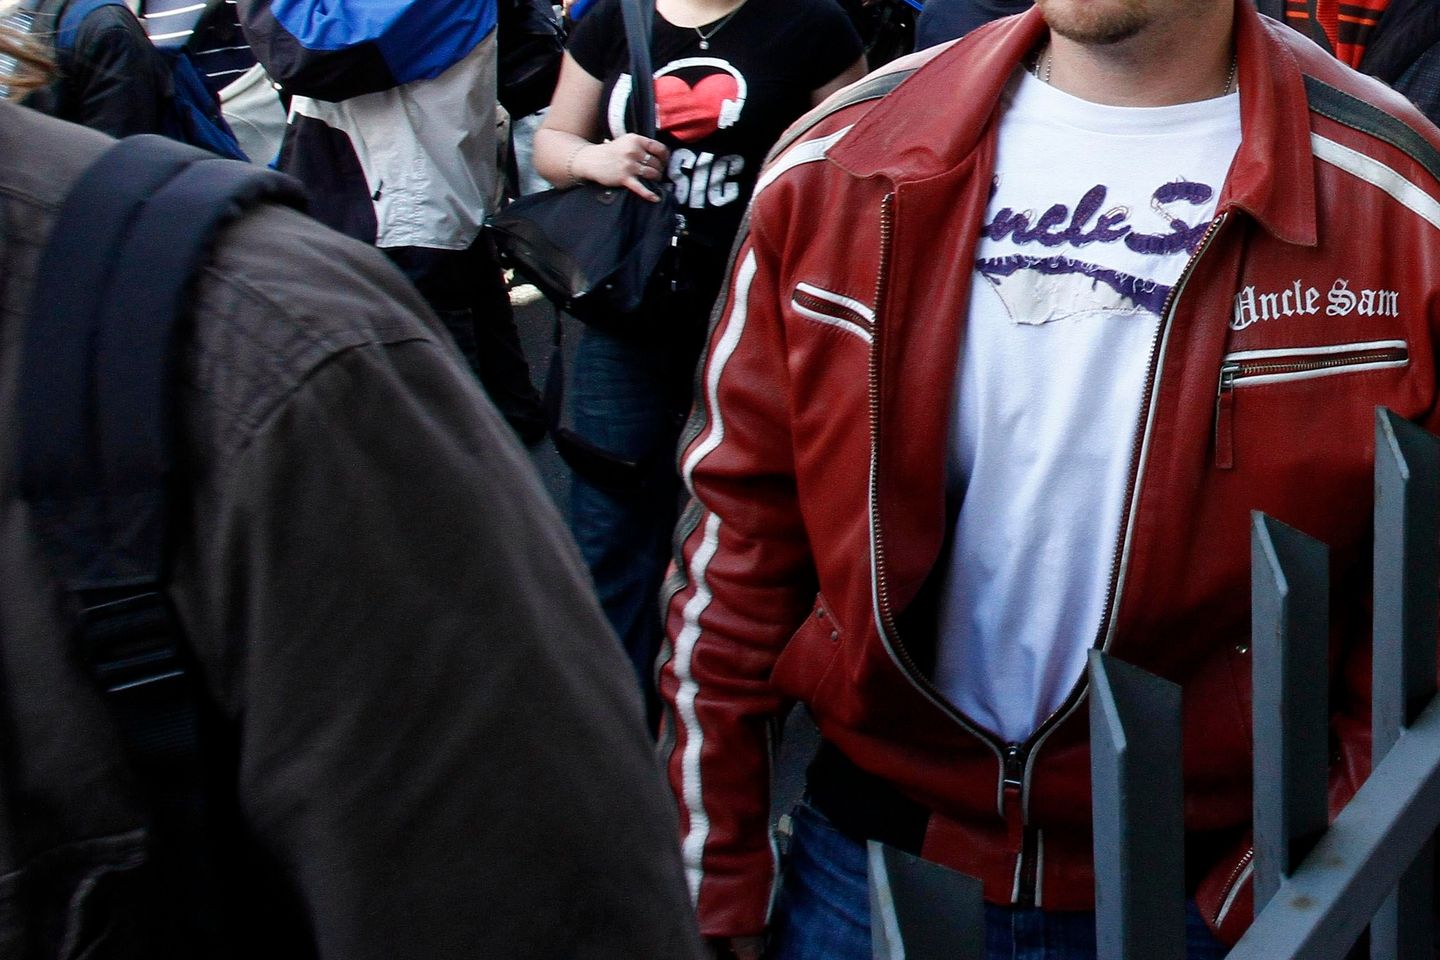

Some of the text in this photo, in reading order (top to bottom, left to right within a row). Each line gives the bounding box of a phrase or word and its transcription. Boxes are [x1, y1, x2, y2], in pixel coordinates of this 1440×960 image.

[668, 148, 746, 209] SIC
[981, 174, 1131, 248] ncle
[1229, 278, 1400, 332] Uncle Sam
